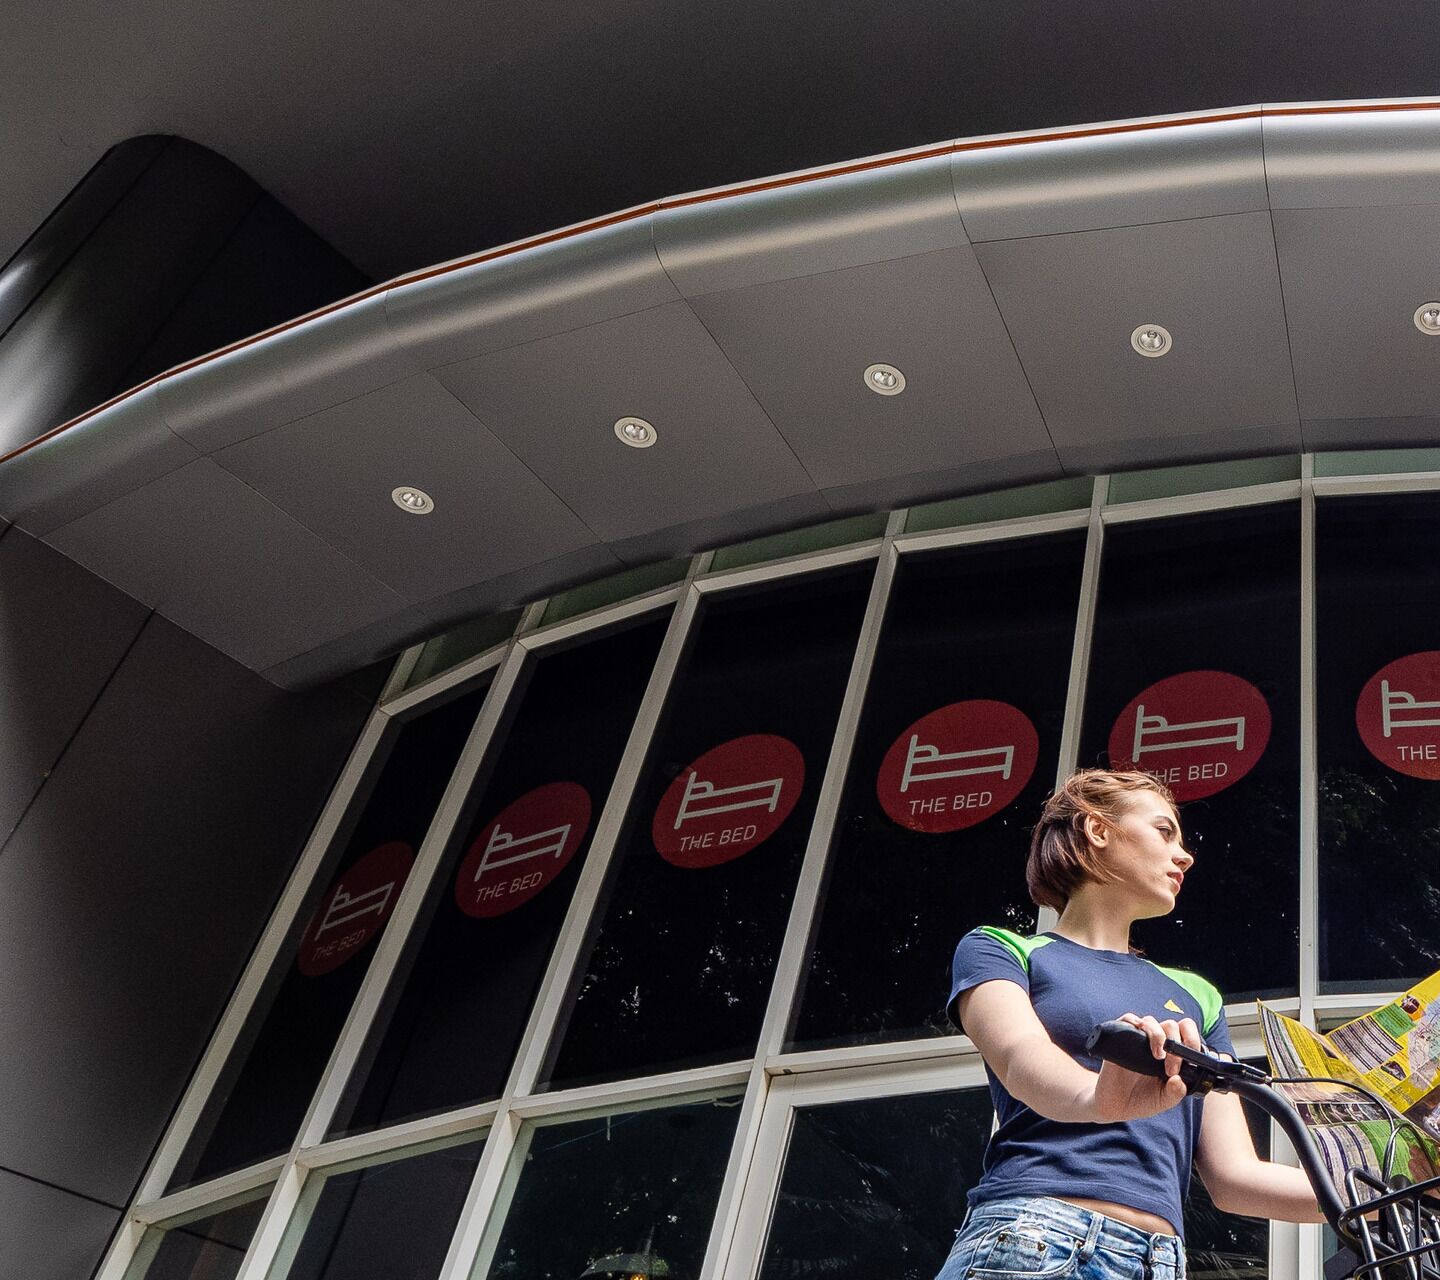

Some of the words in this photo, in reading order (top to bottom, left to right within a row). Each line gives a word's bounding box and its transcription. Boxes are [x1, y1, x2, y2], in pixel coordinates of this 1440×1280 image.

[1398, 745, 1439, 762] THE
[1188, 762, 1228, 781] BED
[909, 797, 949, 816] THE
[953, 791, 992, 810] BED
[680, 832, 715, 852] THE
[719, 824, 757, 845] BED
[476, 881, 508, 904] THE
[509, 871, 543, 894] BED
